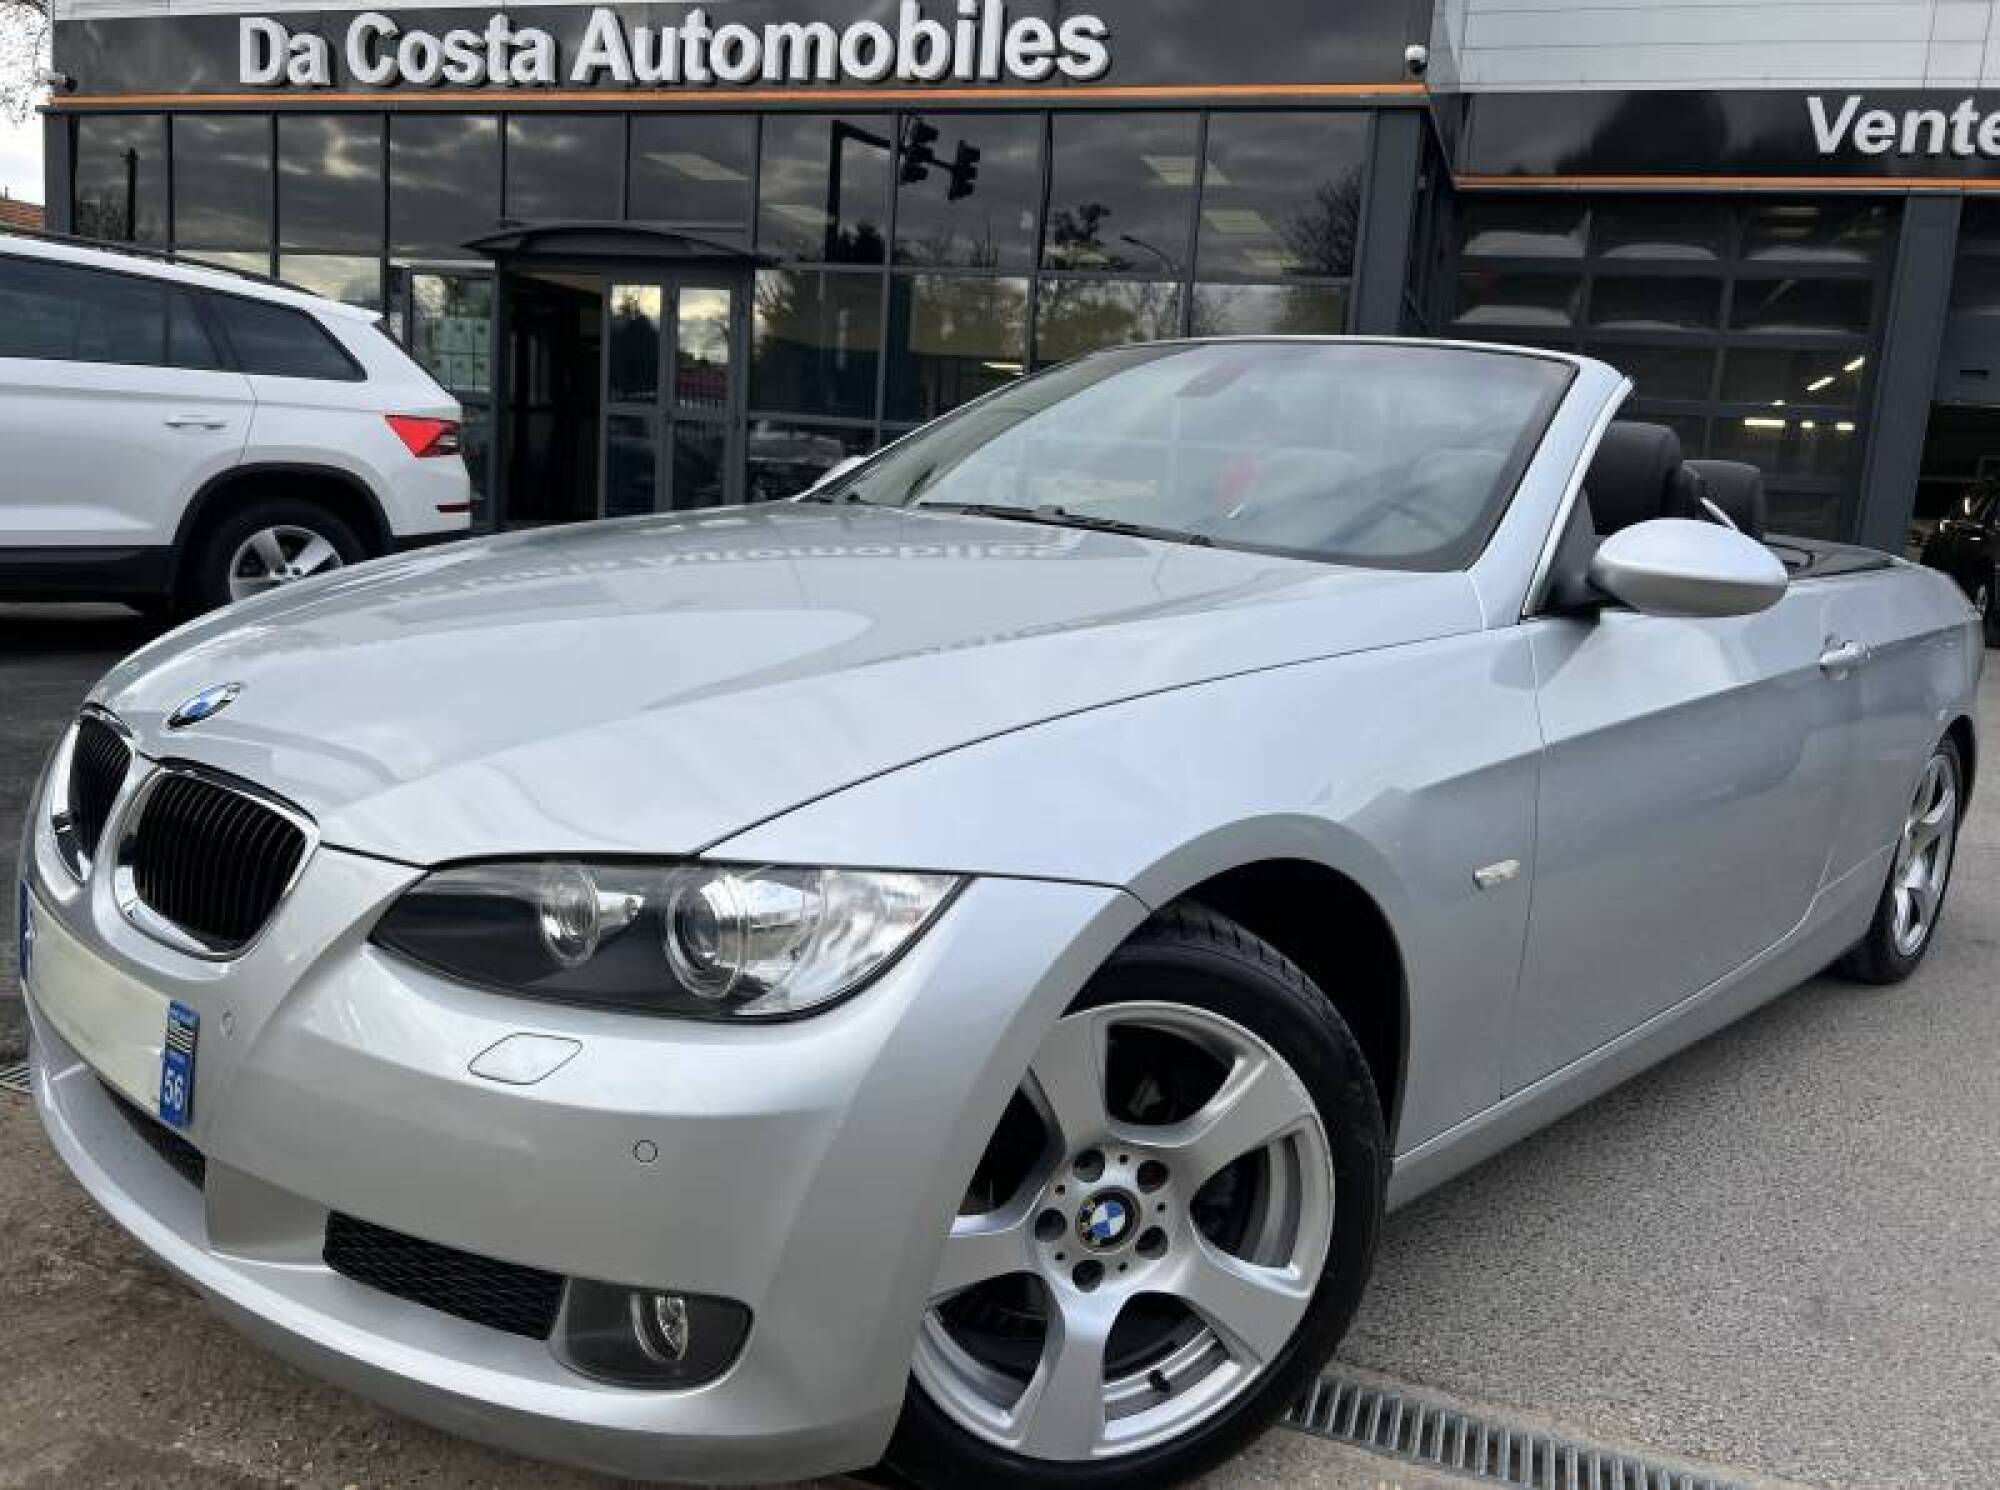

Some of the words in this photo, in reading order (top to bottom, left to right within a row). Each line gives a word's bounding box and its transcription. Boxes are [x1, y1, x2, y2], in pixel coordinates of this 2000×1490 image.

[239, 17, 331, 85] Da
[347, 12, 556, 84] Costa
[569, 0, 1112, 83] Automobiles
[164, 1066, 185, 1111] 56
